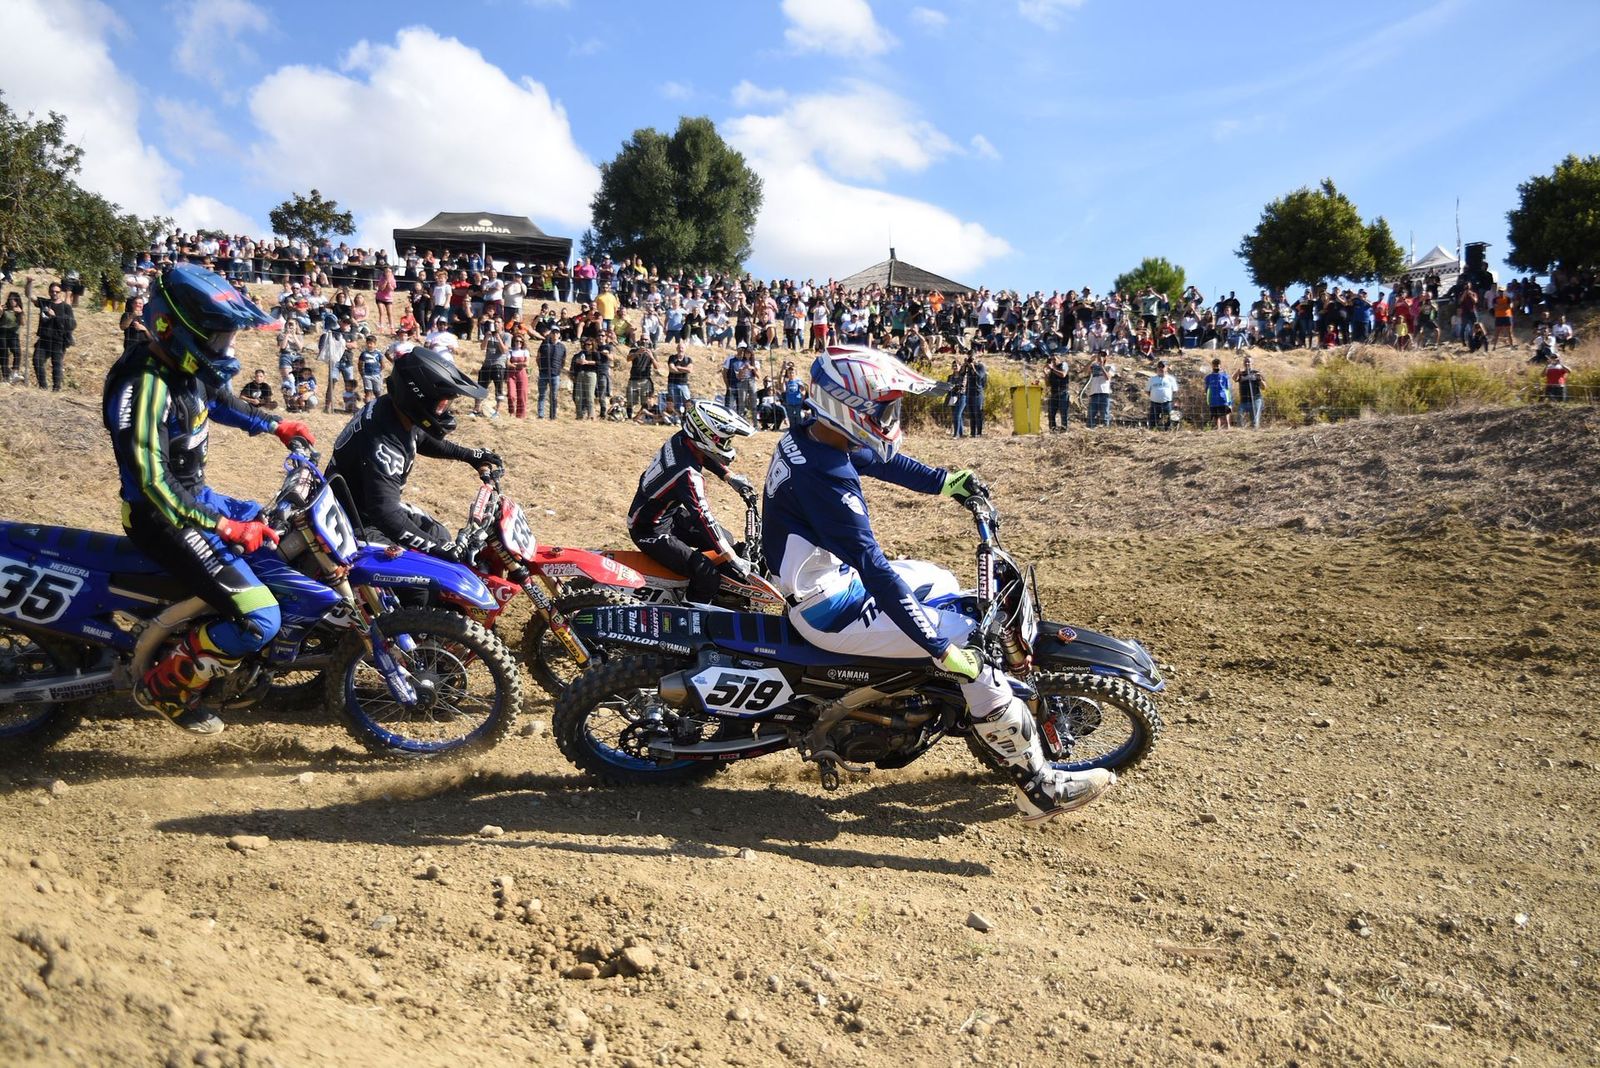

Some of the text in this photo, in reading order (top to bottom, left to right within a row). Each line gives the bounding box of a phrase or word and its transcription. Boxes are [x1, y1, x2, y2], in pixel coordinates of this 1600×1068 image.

[459, 225, 511, 234] YAMAHA
[408, 381, 425, 399] FOX
[821, 379, 879, 415] 100%
[119, 385, 134, 430] YAMAHA
[779, 430, 807, 465] RICIO
[948, 472, 967, 489] THOR
[184, 528, 224, 577] YAMAHA
[400, 531, 437, 553] FOX
[49, 562, 90, 578] HERRERA
[0, 563, 83, 622] 35
[629, 610, 638, 633] Bihr
[900, 593, 938, 640] THOR
[607, 632, 659, 646] DUNLOP
[667, 642, 691, 654] YAMAHA
[837, 669, 870, 680] YAMAHA
[934, 669, 960, 680] cetele
[705, 672, 784, 710] 519
